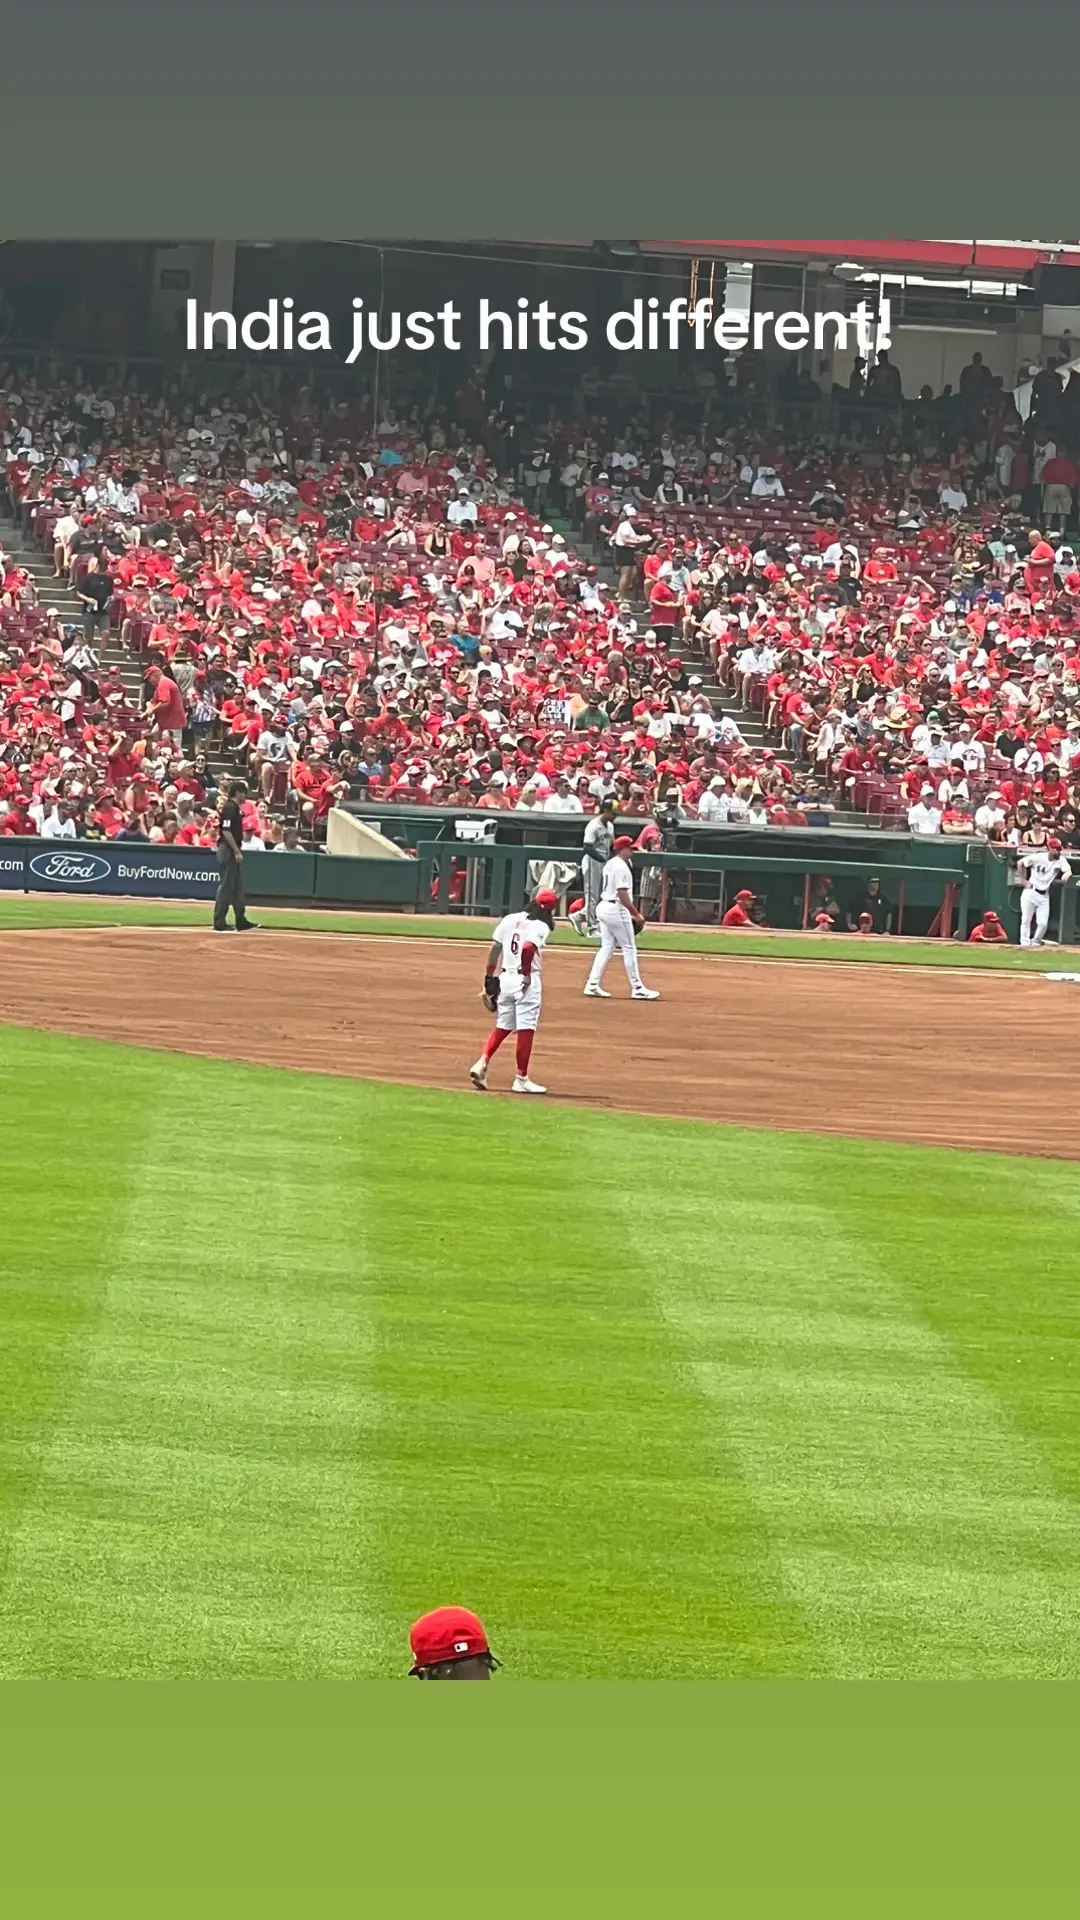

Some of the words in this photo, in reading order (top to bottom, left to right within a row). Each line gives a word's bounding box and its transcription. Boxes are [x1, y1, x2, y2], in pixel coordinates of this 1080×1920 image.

[45, 855, 96, 878] Ford
[118, 865, 220, 881] BuyFordNow.com
[511, 932, 520, 955] 6
